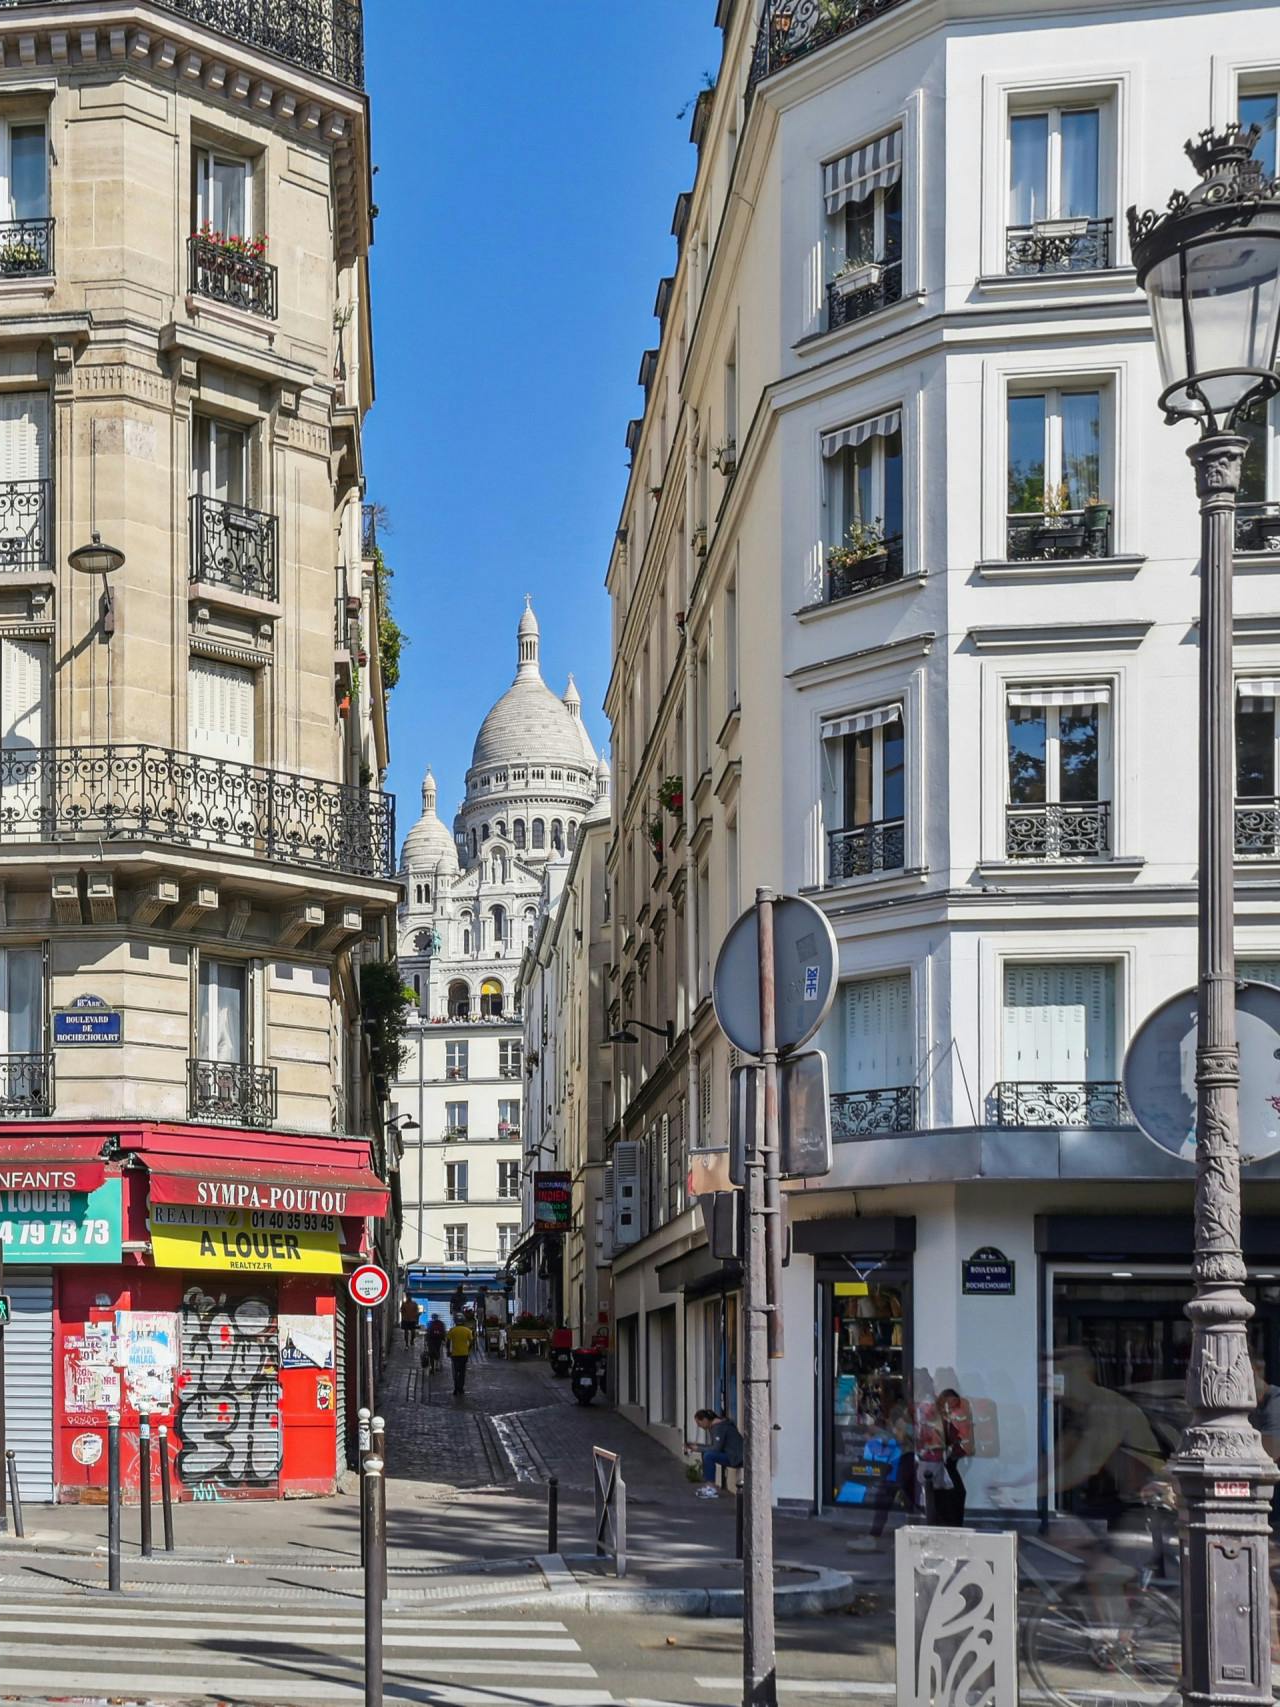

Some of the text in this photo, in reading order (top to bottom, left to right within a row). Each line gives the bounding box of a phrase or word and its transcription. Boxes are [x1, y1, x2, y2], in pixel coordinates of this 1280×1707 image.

[66, 1015, 109, 1024] BOULEVARD
[57, 1033, 119, 1041] ROCHECHOUART
[8, 1191, 71, 1213] LOUER
[198, 1182, 347, 1213] SYMPA-POUTOU
[251, 1211, 265, 1228] 01
[270, 1212, 284, 1229] 40
[287, 1212, 301, 1230] 35
[304, 1213, 318, 1230] 93
[321, 1214, 334, 1232] 45
[20, 1219, 45, 1246] 79
[51, 1219, 77, 1246] 73
[83, 1219, 110, 1246] 73
[200, 1230, 301, 1260] A LOUER
[230, 1261, 273, 1270] REALTYZ.FR
[970, 1266, 1007, 1274] BOULEVARD
